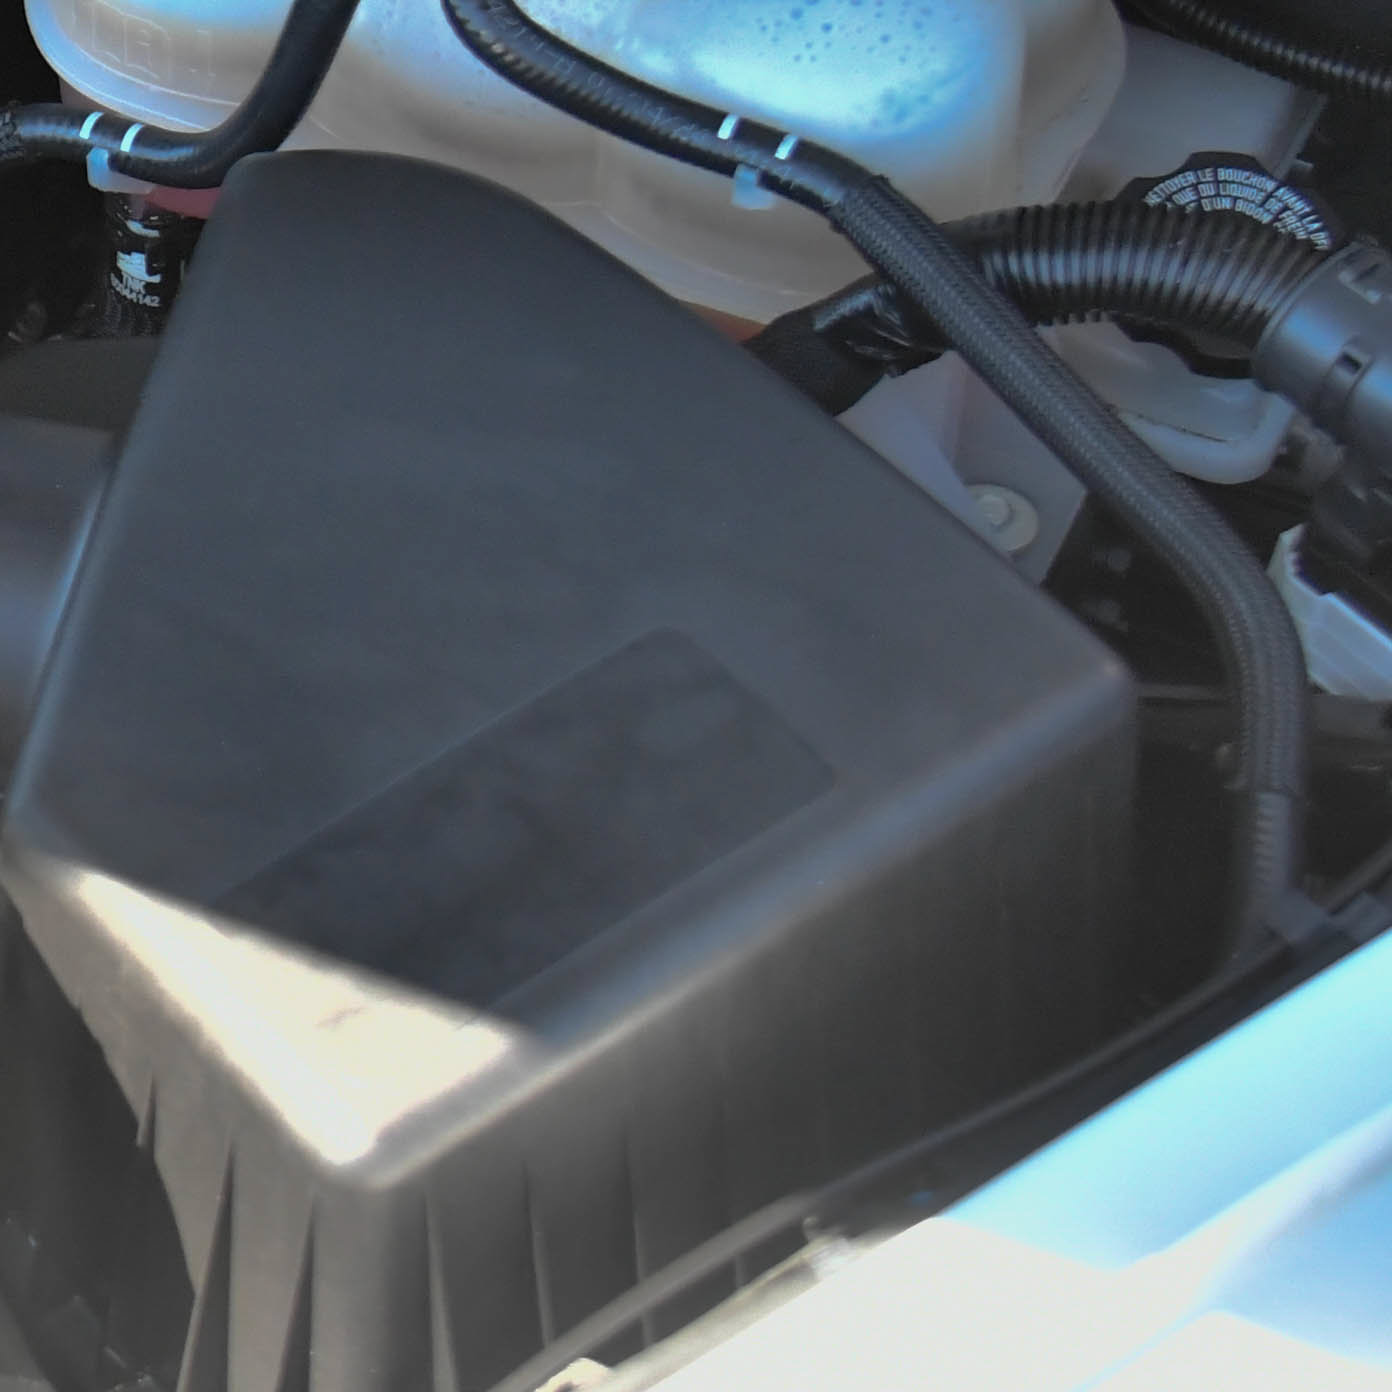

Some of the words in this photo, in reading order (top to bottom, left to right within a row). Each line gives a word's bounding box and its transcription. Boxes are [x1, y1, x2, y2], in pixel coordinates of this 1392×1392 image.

[1171, 187, 1198, 205] QUE
[1198, 182, 1216, 197] DU
[1218, 182, 1265, 204] LIQUIDE
[1264, 197, 1284, 215] DE
[1278, 210, 1308, 240] FREIN
[1197, 168, 1215, 182] LE
[1217, 167, 1279, 194] BOUCHON
[1272, 186, 1314, 216] AVANT
[1303, 214, 1323, 231] LA
[1200, 196, 1234, 212] D'UN
[1234, 197, 1274, 224] BIDON
